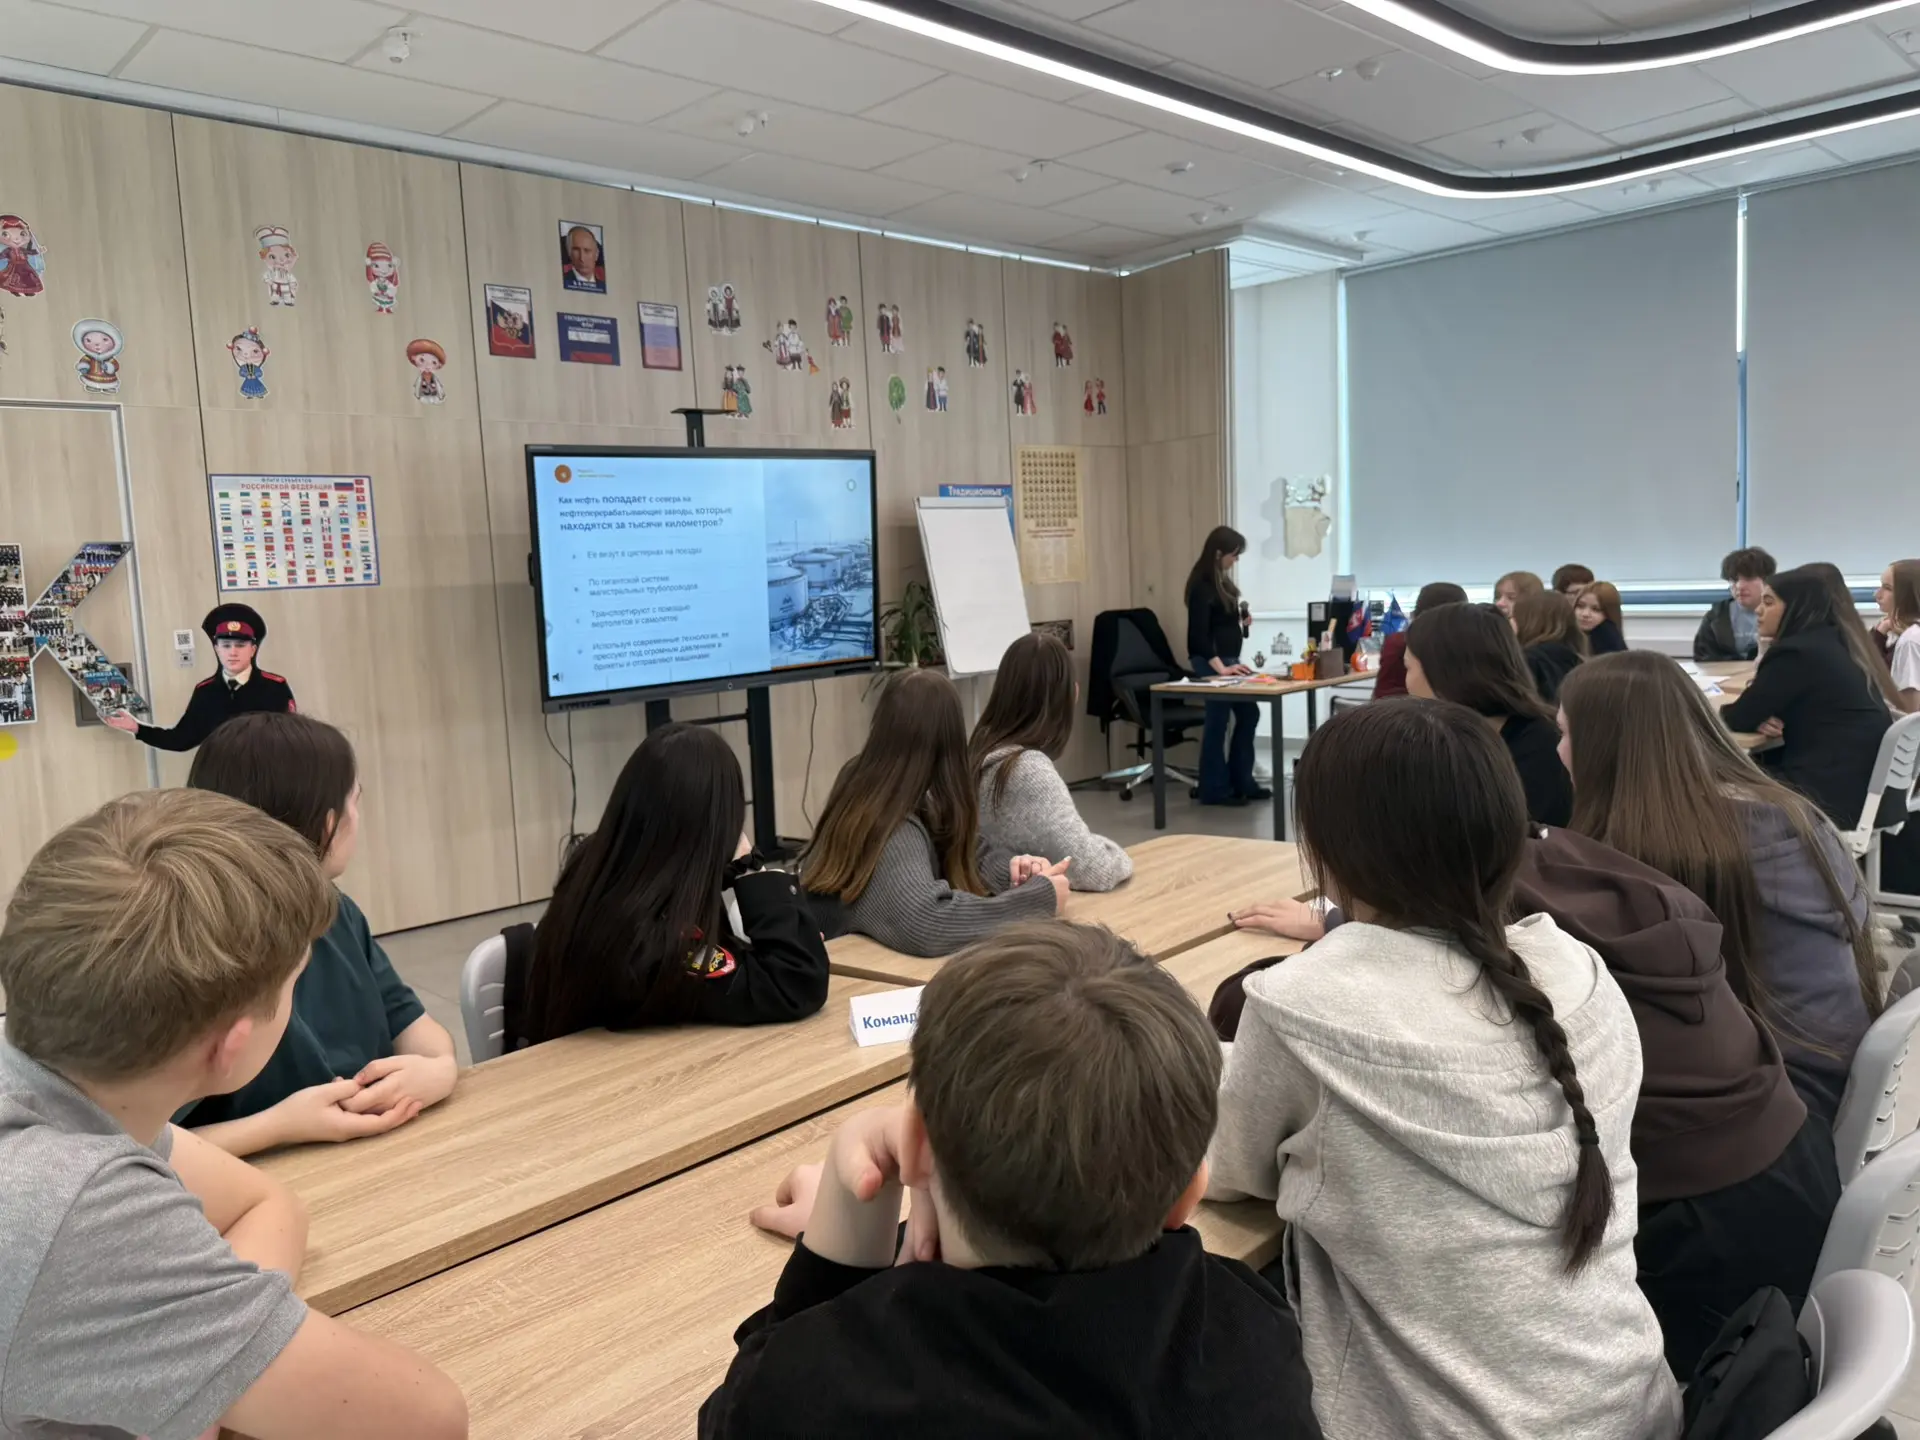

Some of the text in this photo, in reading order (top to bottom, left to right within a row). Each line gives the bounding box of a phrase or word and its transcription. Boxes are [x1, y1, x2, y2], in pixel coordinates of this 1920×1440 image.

[558, 496, 572, 504] Как
[574, 496, 600, 504] нефть
[602, 495, 647, 506] попадает
[695, 507, 732, 515] которые
[560, 517, 723, 532] находятся за тысячи километров?
[588, 578, 600, 586] По
[592, 640, 632, 651] Используя
[863, 1012, 917, 1029] Команд
